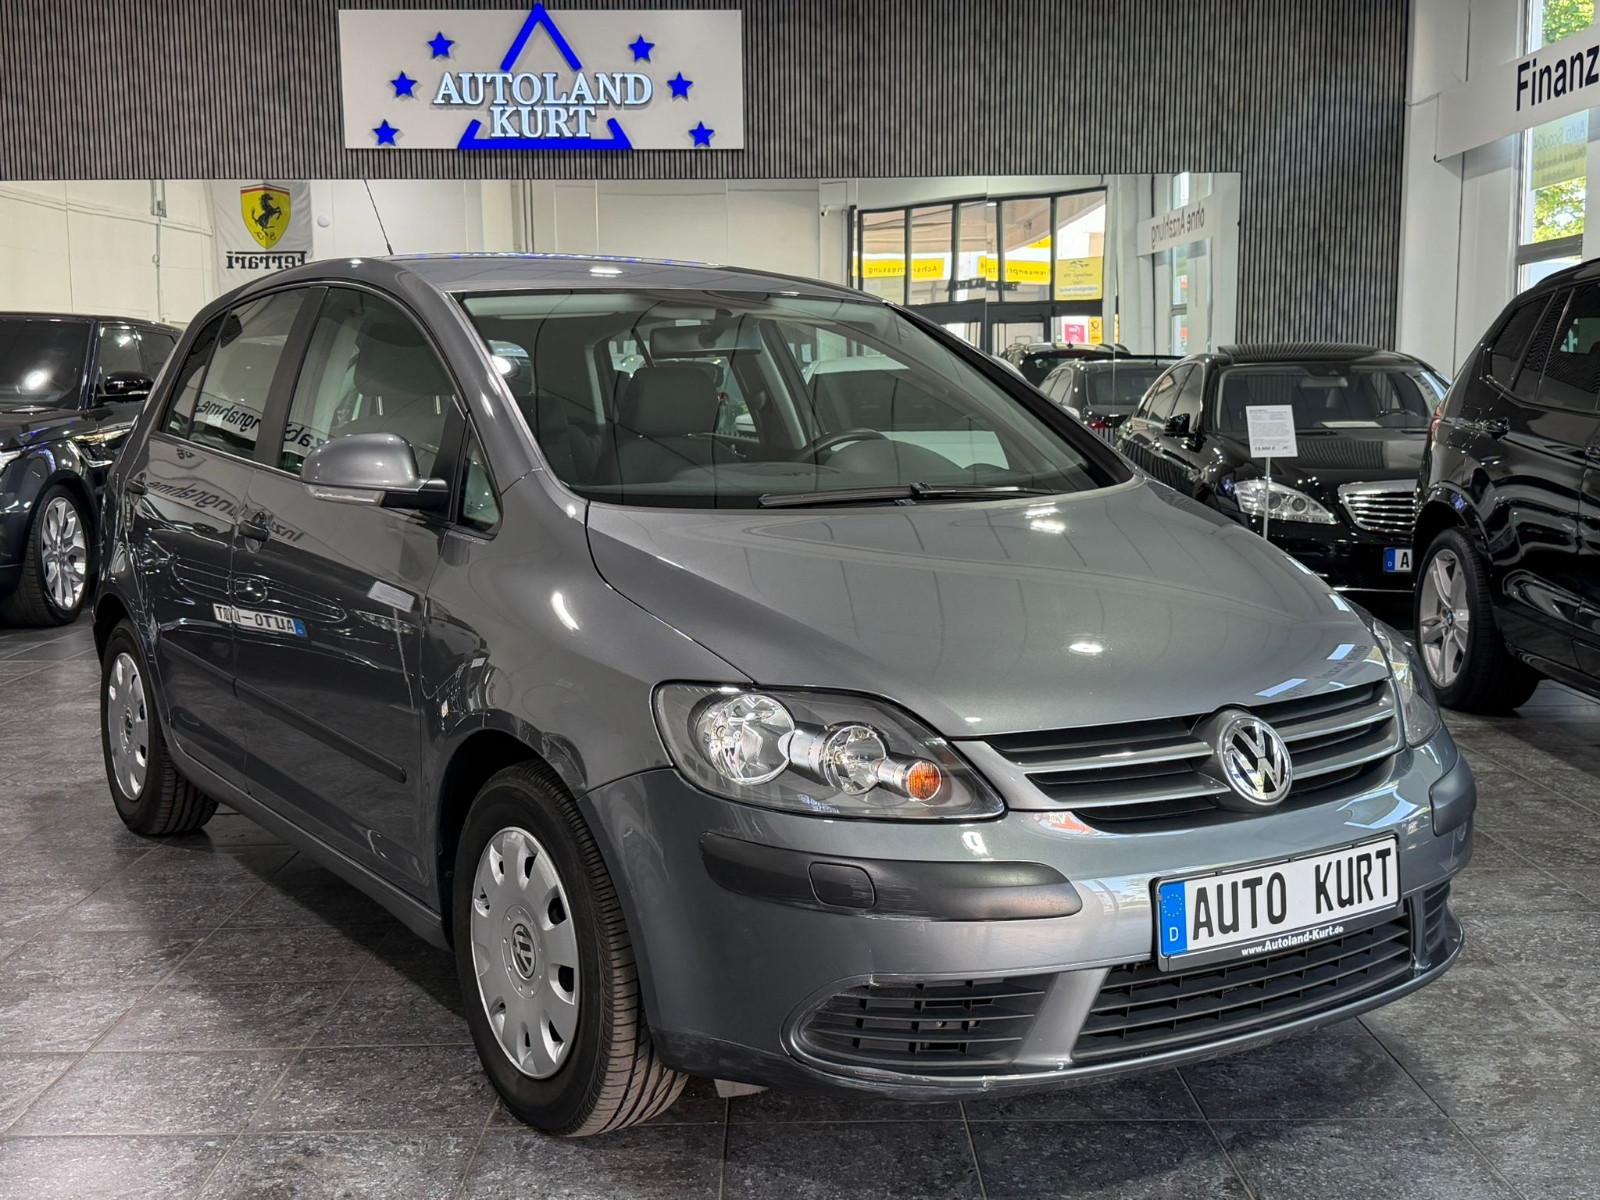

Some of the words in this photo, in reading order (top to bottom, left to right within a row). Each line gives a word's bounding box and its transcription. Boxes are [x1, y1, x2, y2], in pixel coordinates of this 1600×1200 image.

[433, 71, 654, 106] AUTOLAND
[1516, 45, 1600, 112] Finanz
[489, 106, 597, 139] KURT
[1192, 871, 1287, 941] AUTO
[1314, 848, 1391, 915] KURT
[1169, 927, 1179, 942] D
[1240, 925, 1344, 956] www.Autoland-Kurt.de
